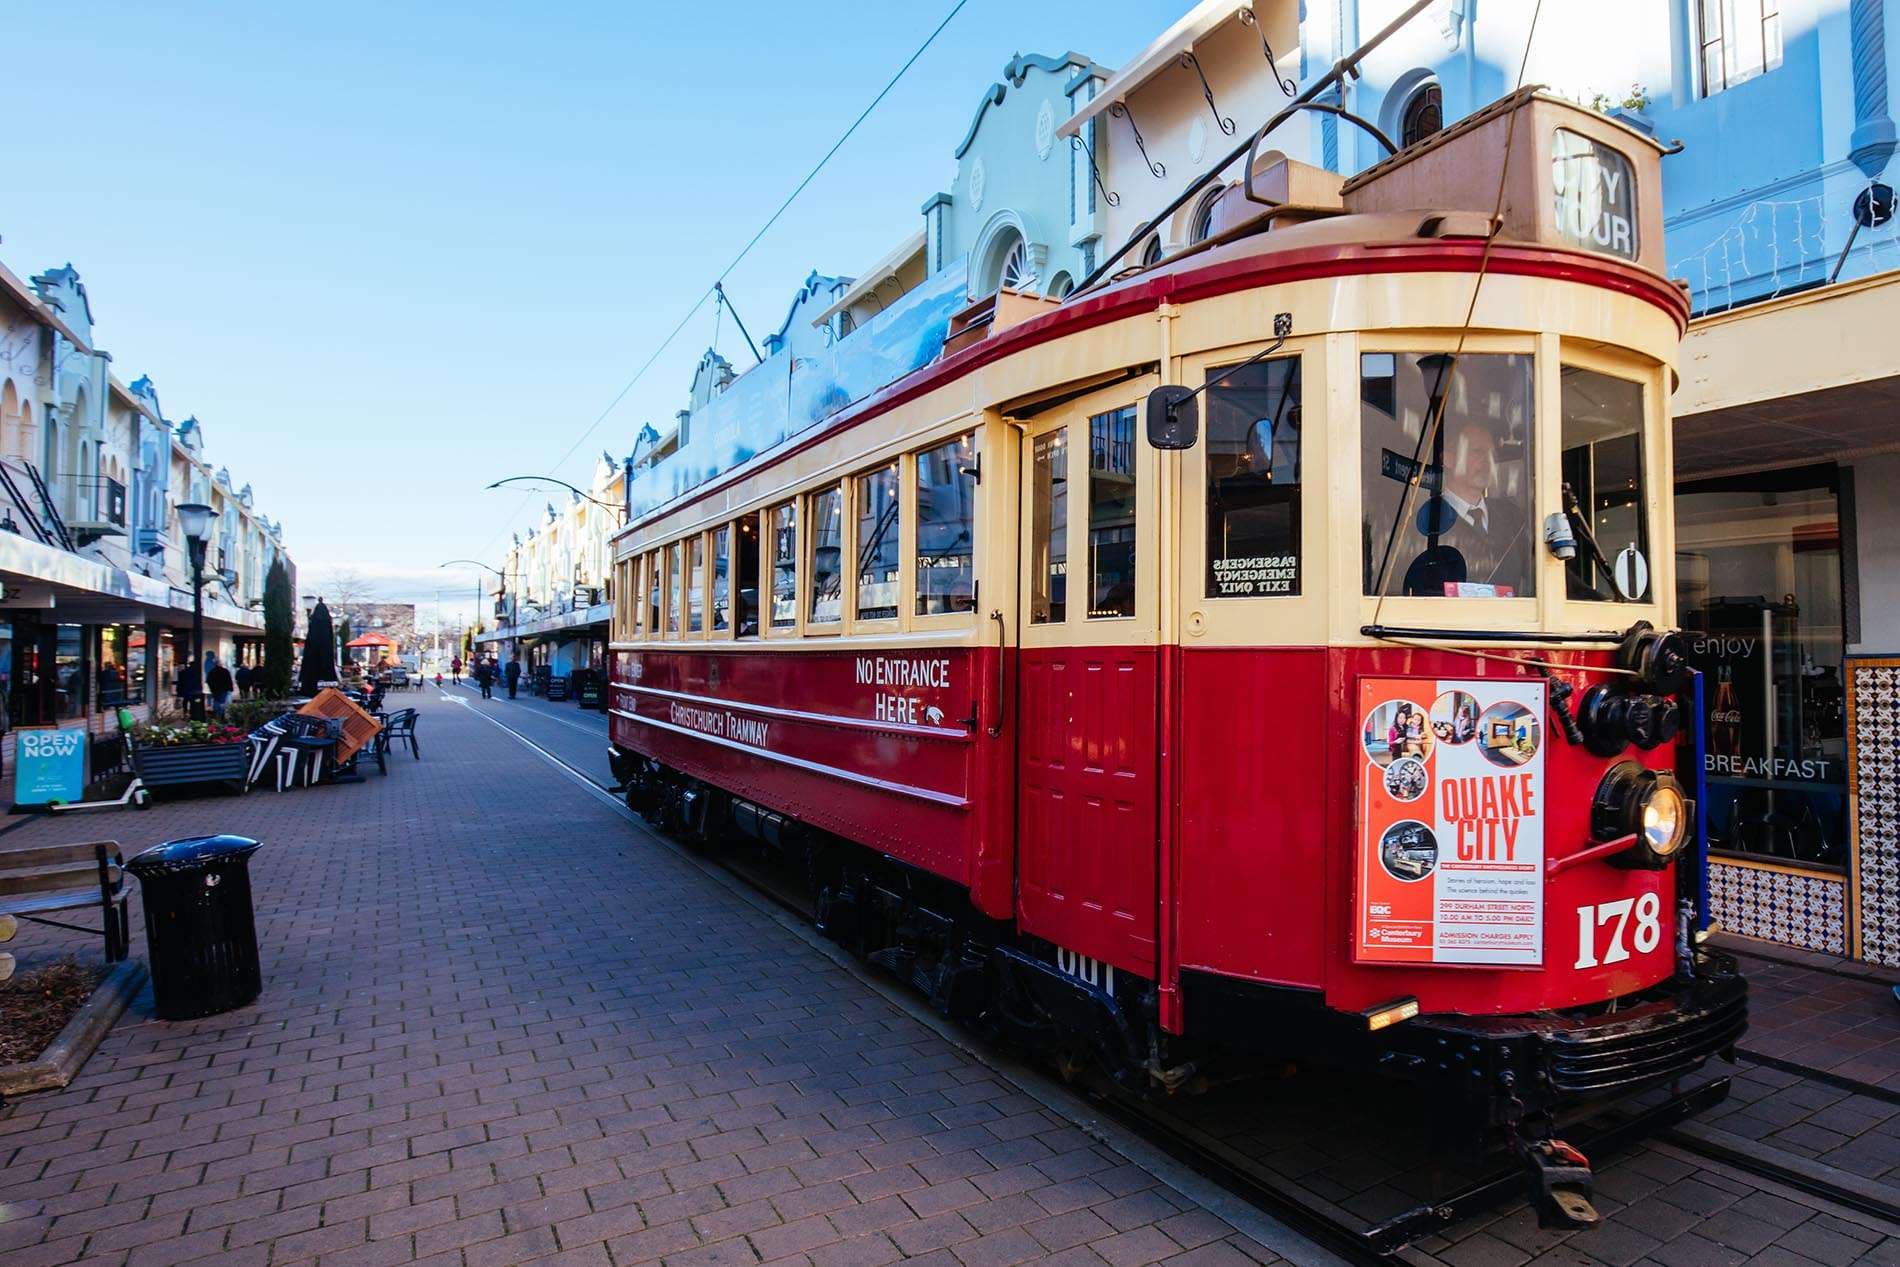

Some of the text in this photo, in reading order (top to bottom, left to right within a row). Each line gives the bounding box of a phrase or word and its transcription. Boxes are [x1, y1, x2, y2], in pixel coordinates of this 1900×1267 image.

[1693, 633, 1755, 658] enjoy
[856, 656, 950, 688] NO ENTRANCE
[876, 692, 917, 724] HERE
[670, 701, 724, 736] CHRISTCHURCH
[725, 711, 768, 747] TRAMWAY
[23, 734, 78, 747] OPEN
[24, 745, 76, 758] NOW
[1704, 754, 1830, 779] BREAKFAST
[1441, 773, 1536, 825] QUAKE
[1457, 817, 1519, 861] CITY
[1369, 905, 1392, 915] EQC
[1487, 903, 1509, 911] STREET
[1574, 892, 1660, 970] 178
